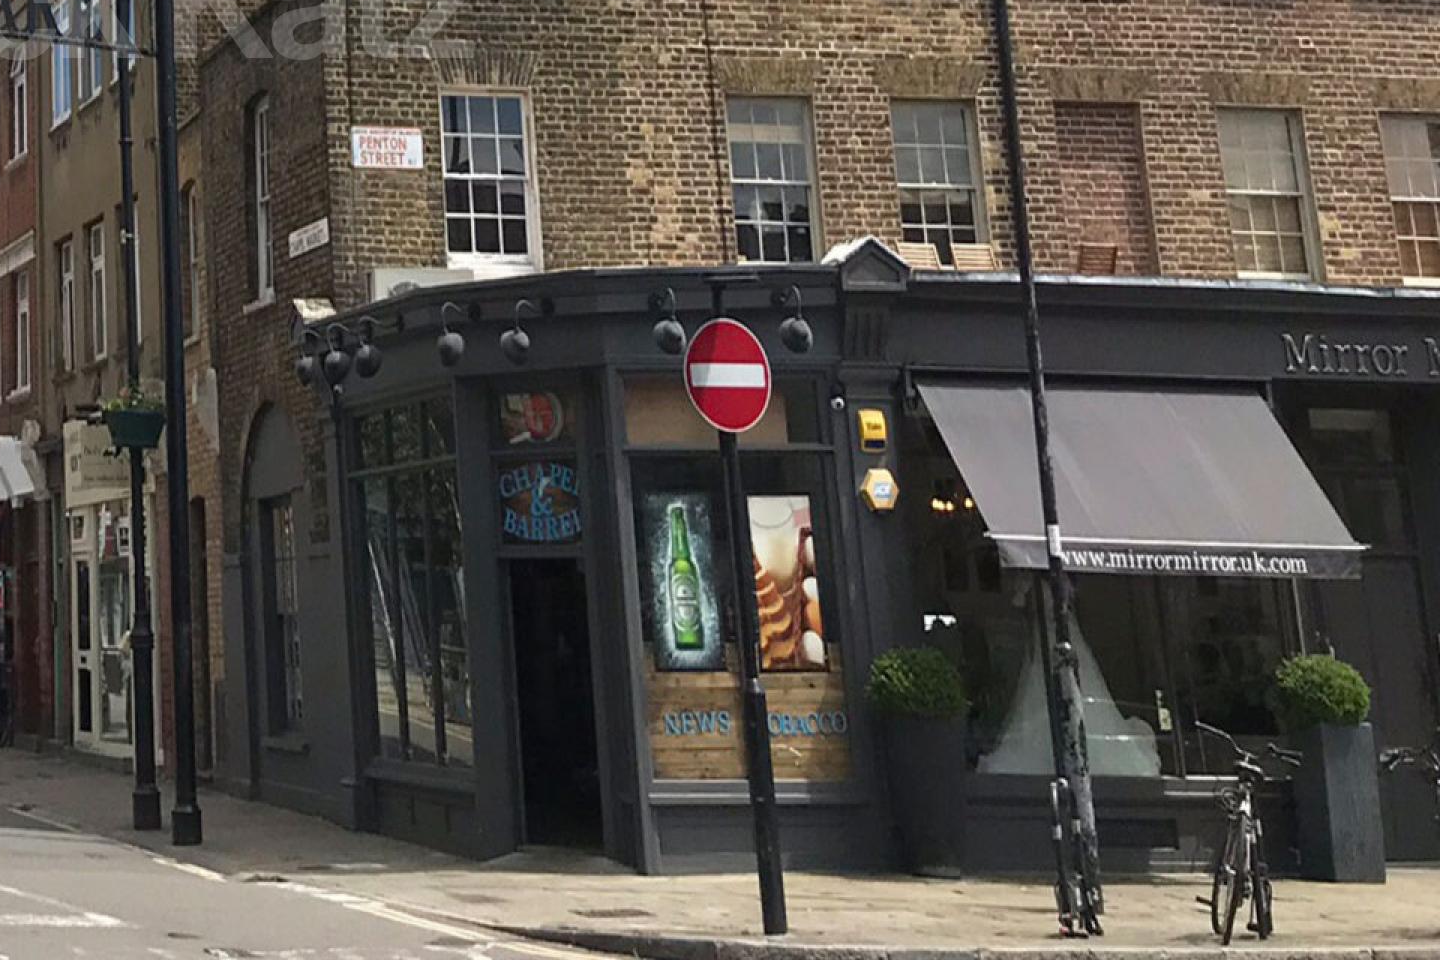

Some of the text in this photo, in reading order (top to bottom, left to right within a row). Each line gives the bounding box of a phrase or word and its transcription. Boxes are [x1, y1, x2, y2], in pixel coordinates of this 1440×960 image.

[359, 137, 407, 151] PENTON
[360, 152, 405, 165] STREET
[1282, 333, 1408, 375] Mirror
[1060, 548, 1308, 575] www.mirrormirror.uk.com
[664, 710, 847, 736] NEWS OBACCO
